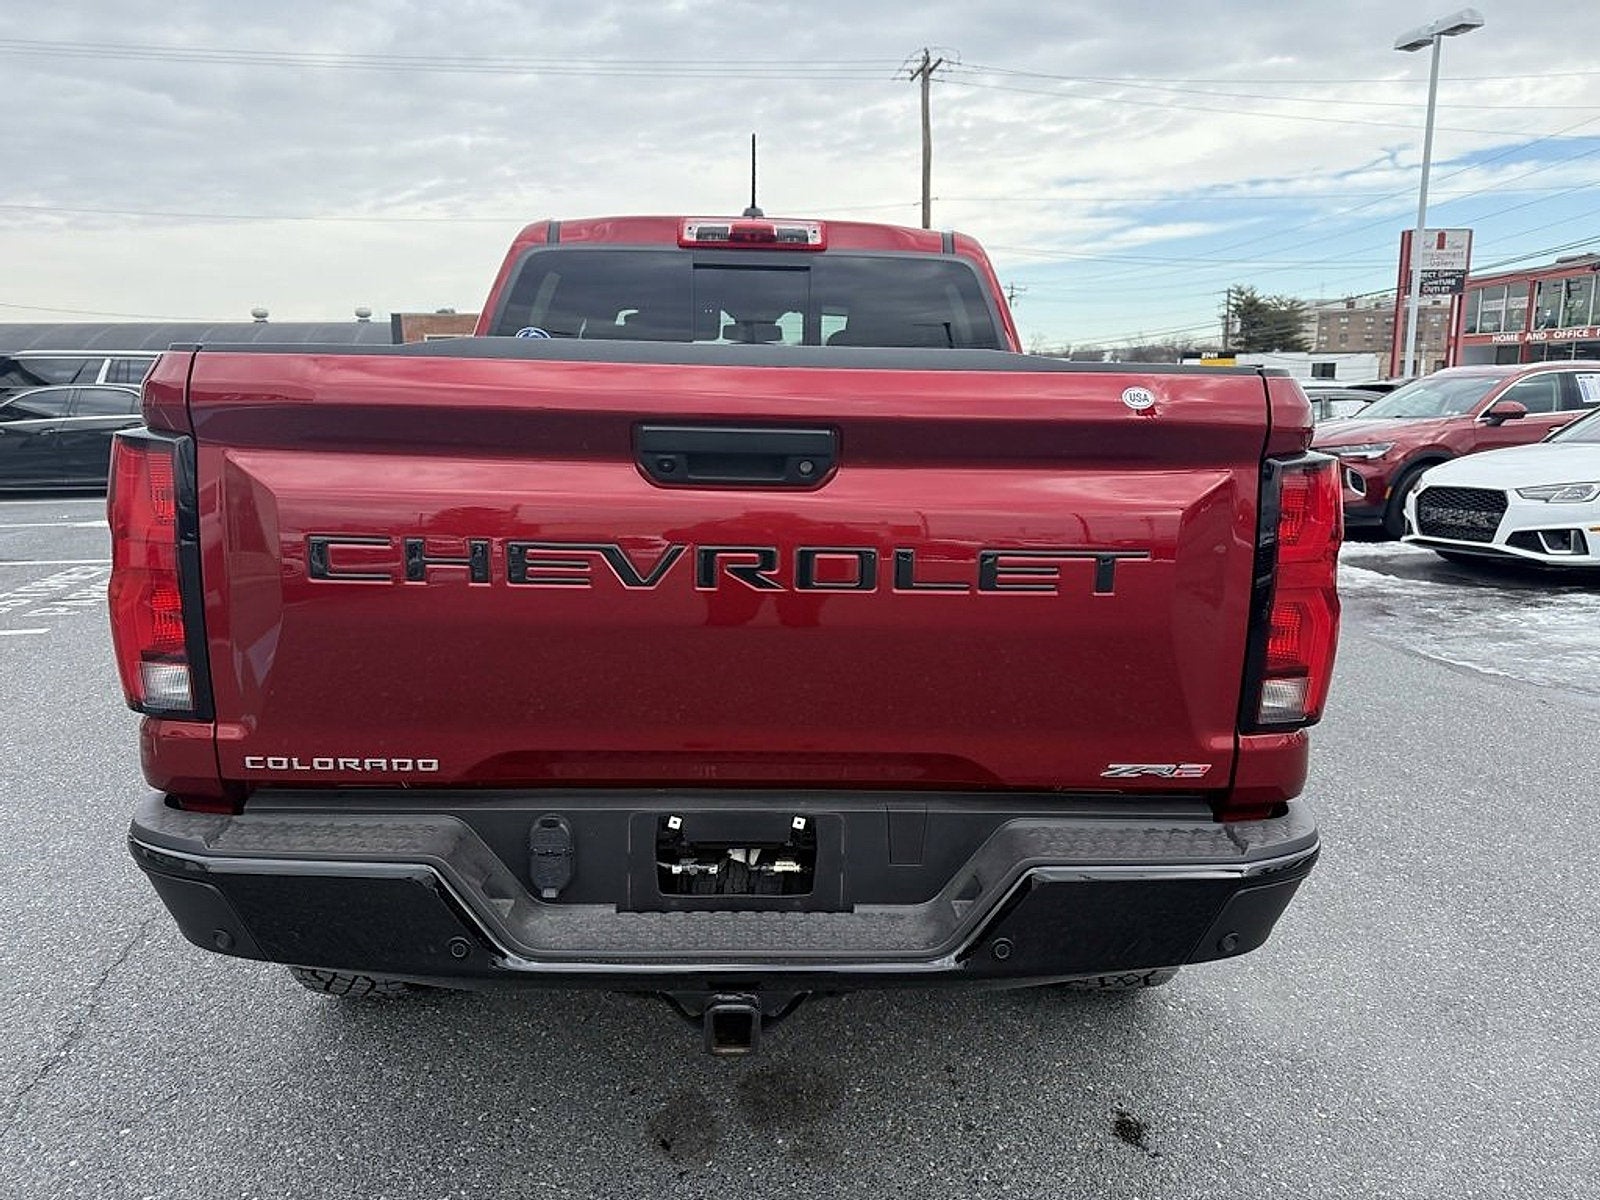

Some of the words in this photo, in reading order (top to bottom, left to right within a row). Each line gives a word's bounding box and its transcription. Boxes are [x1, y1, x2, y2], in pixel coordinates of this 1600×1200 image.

[1492, 333, 1520, 343] HOME
[1525, 331, 1548, 342] AND
[1553, 329, 1589, 339] OFFICE
[1129, 392, 1150, 403] USA
[306, 534, 1151, 598] CHEVROLET
[244, 756, 439, 771] COLORADO
[1100, 763, 1212, 778] ZR2
